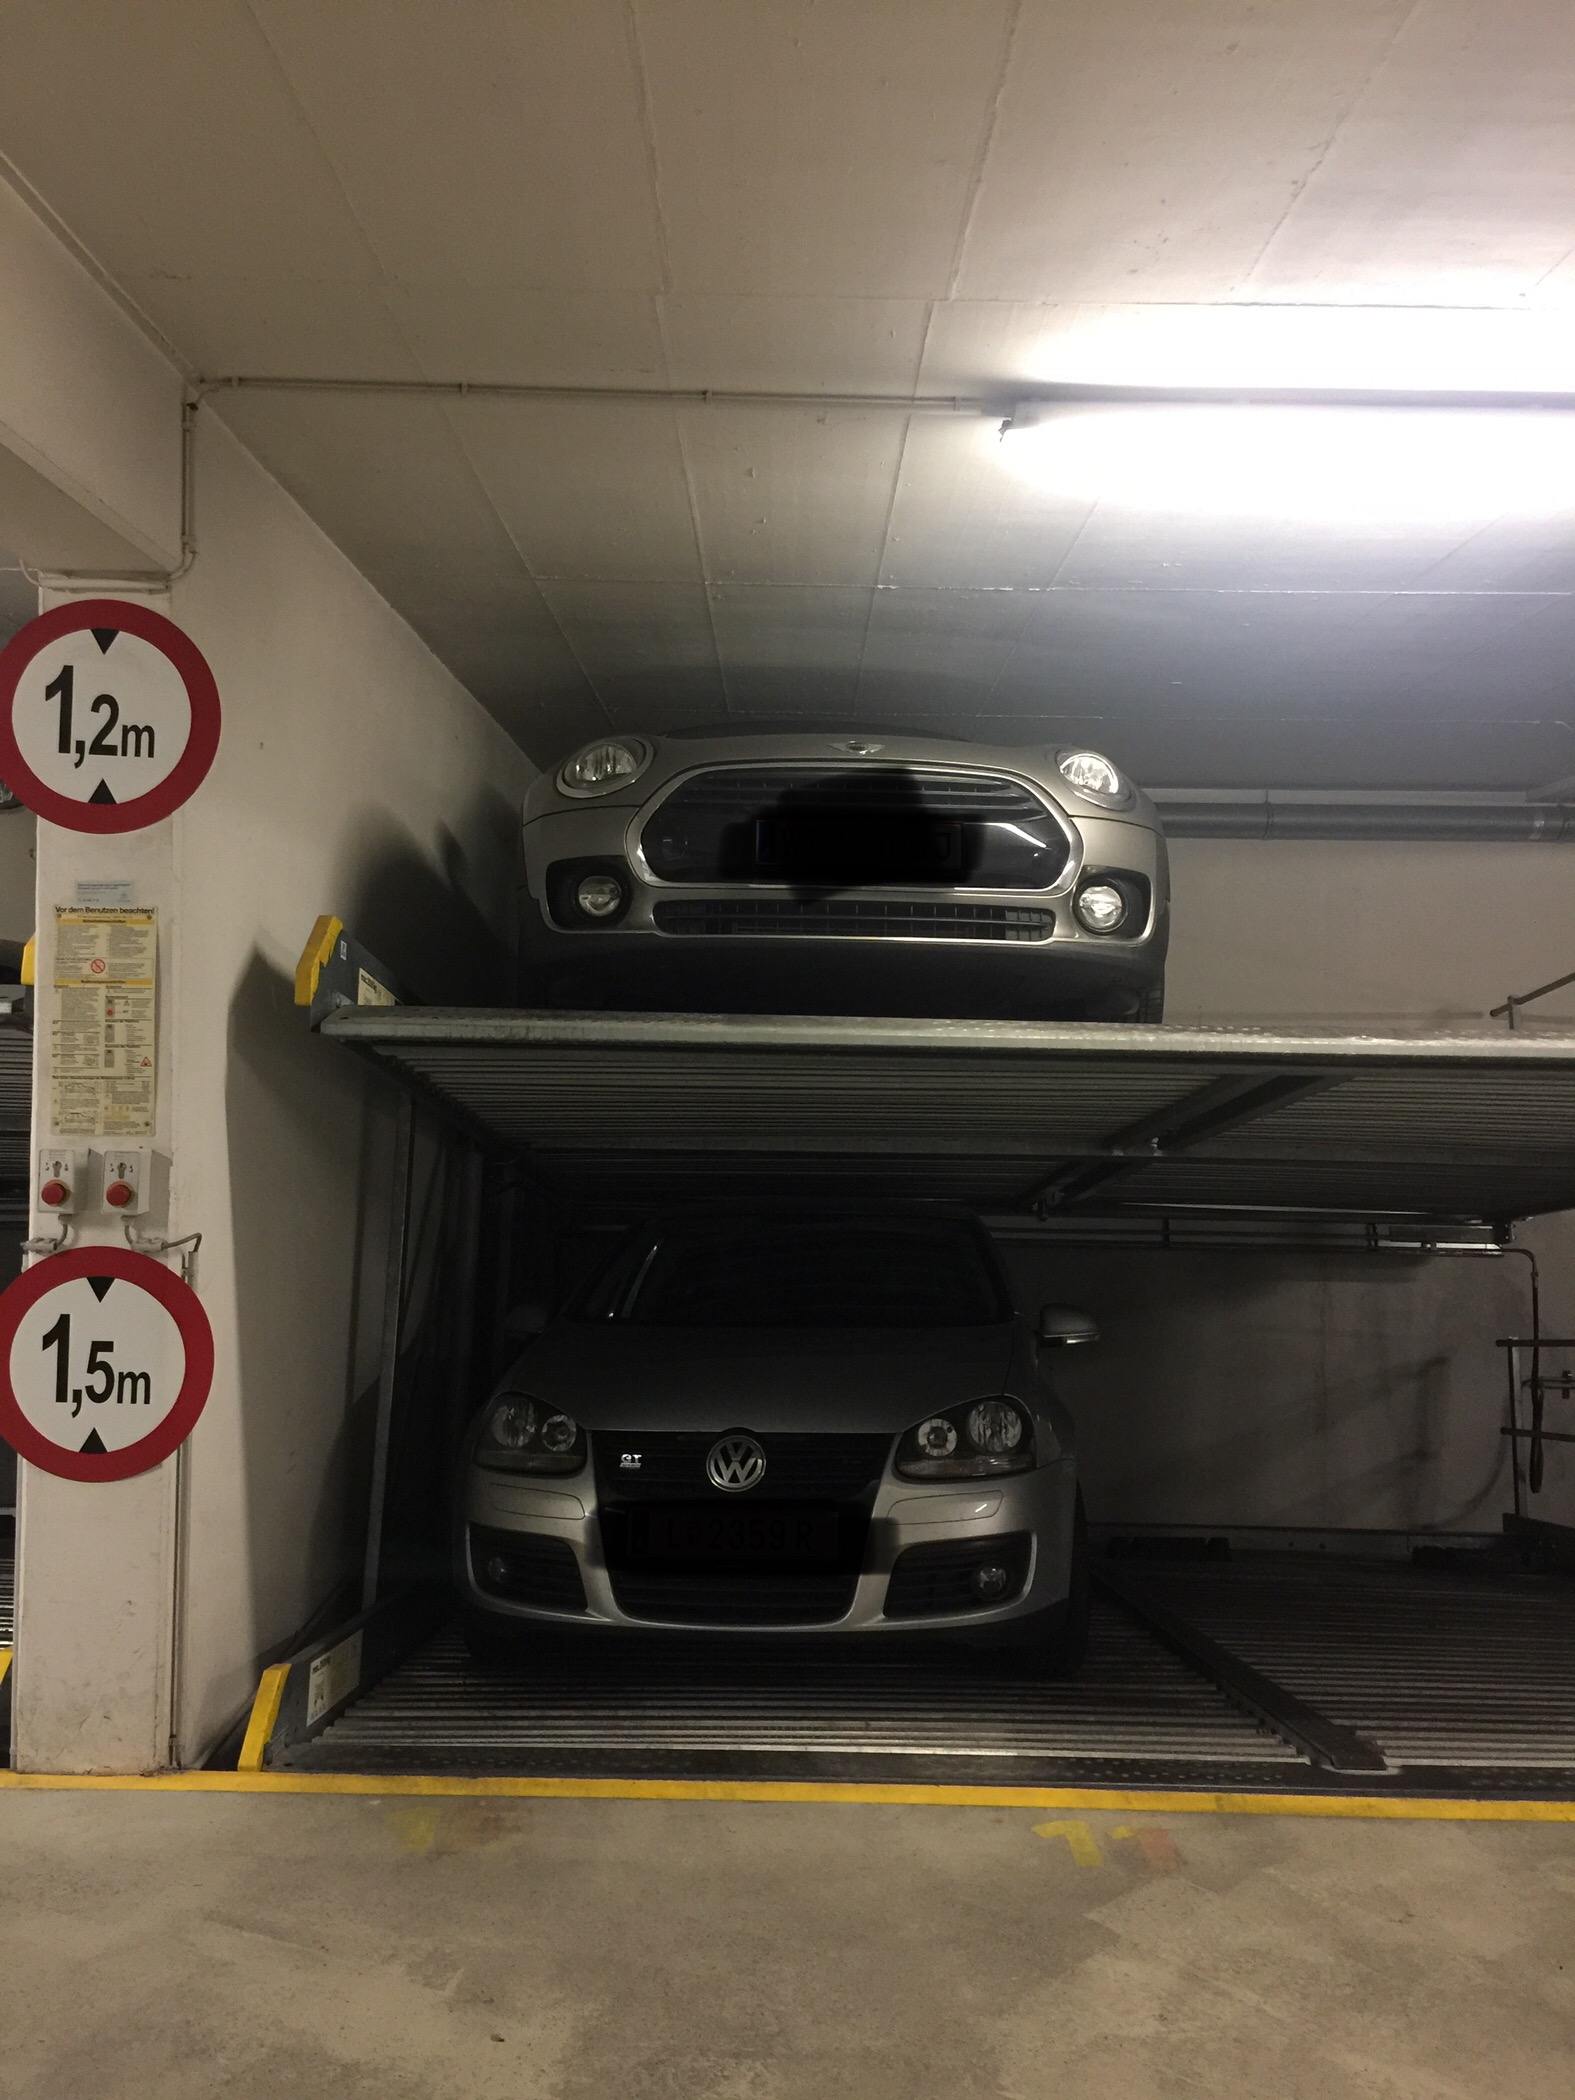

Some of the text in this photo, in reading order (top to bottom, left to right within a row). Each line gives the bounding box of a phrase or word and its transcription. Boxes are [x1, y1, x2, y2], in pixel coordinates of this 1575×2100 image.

[45, 664, 156, 769] 1,2m
[54, 906, 155, 915] Vor dem Benutzen beachten!
[42, 1313, 152, 1419] 1,5m
